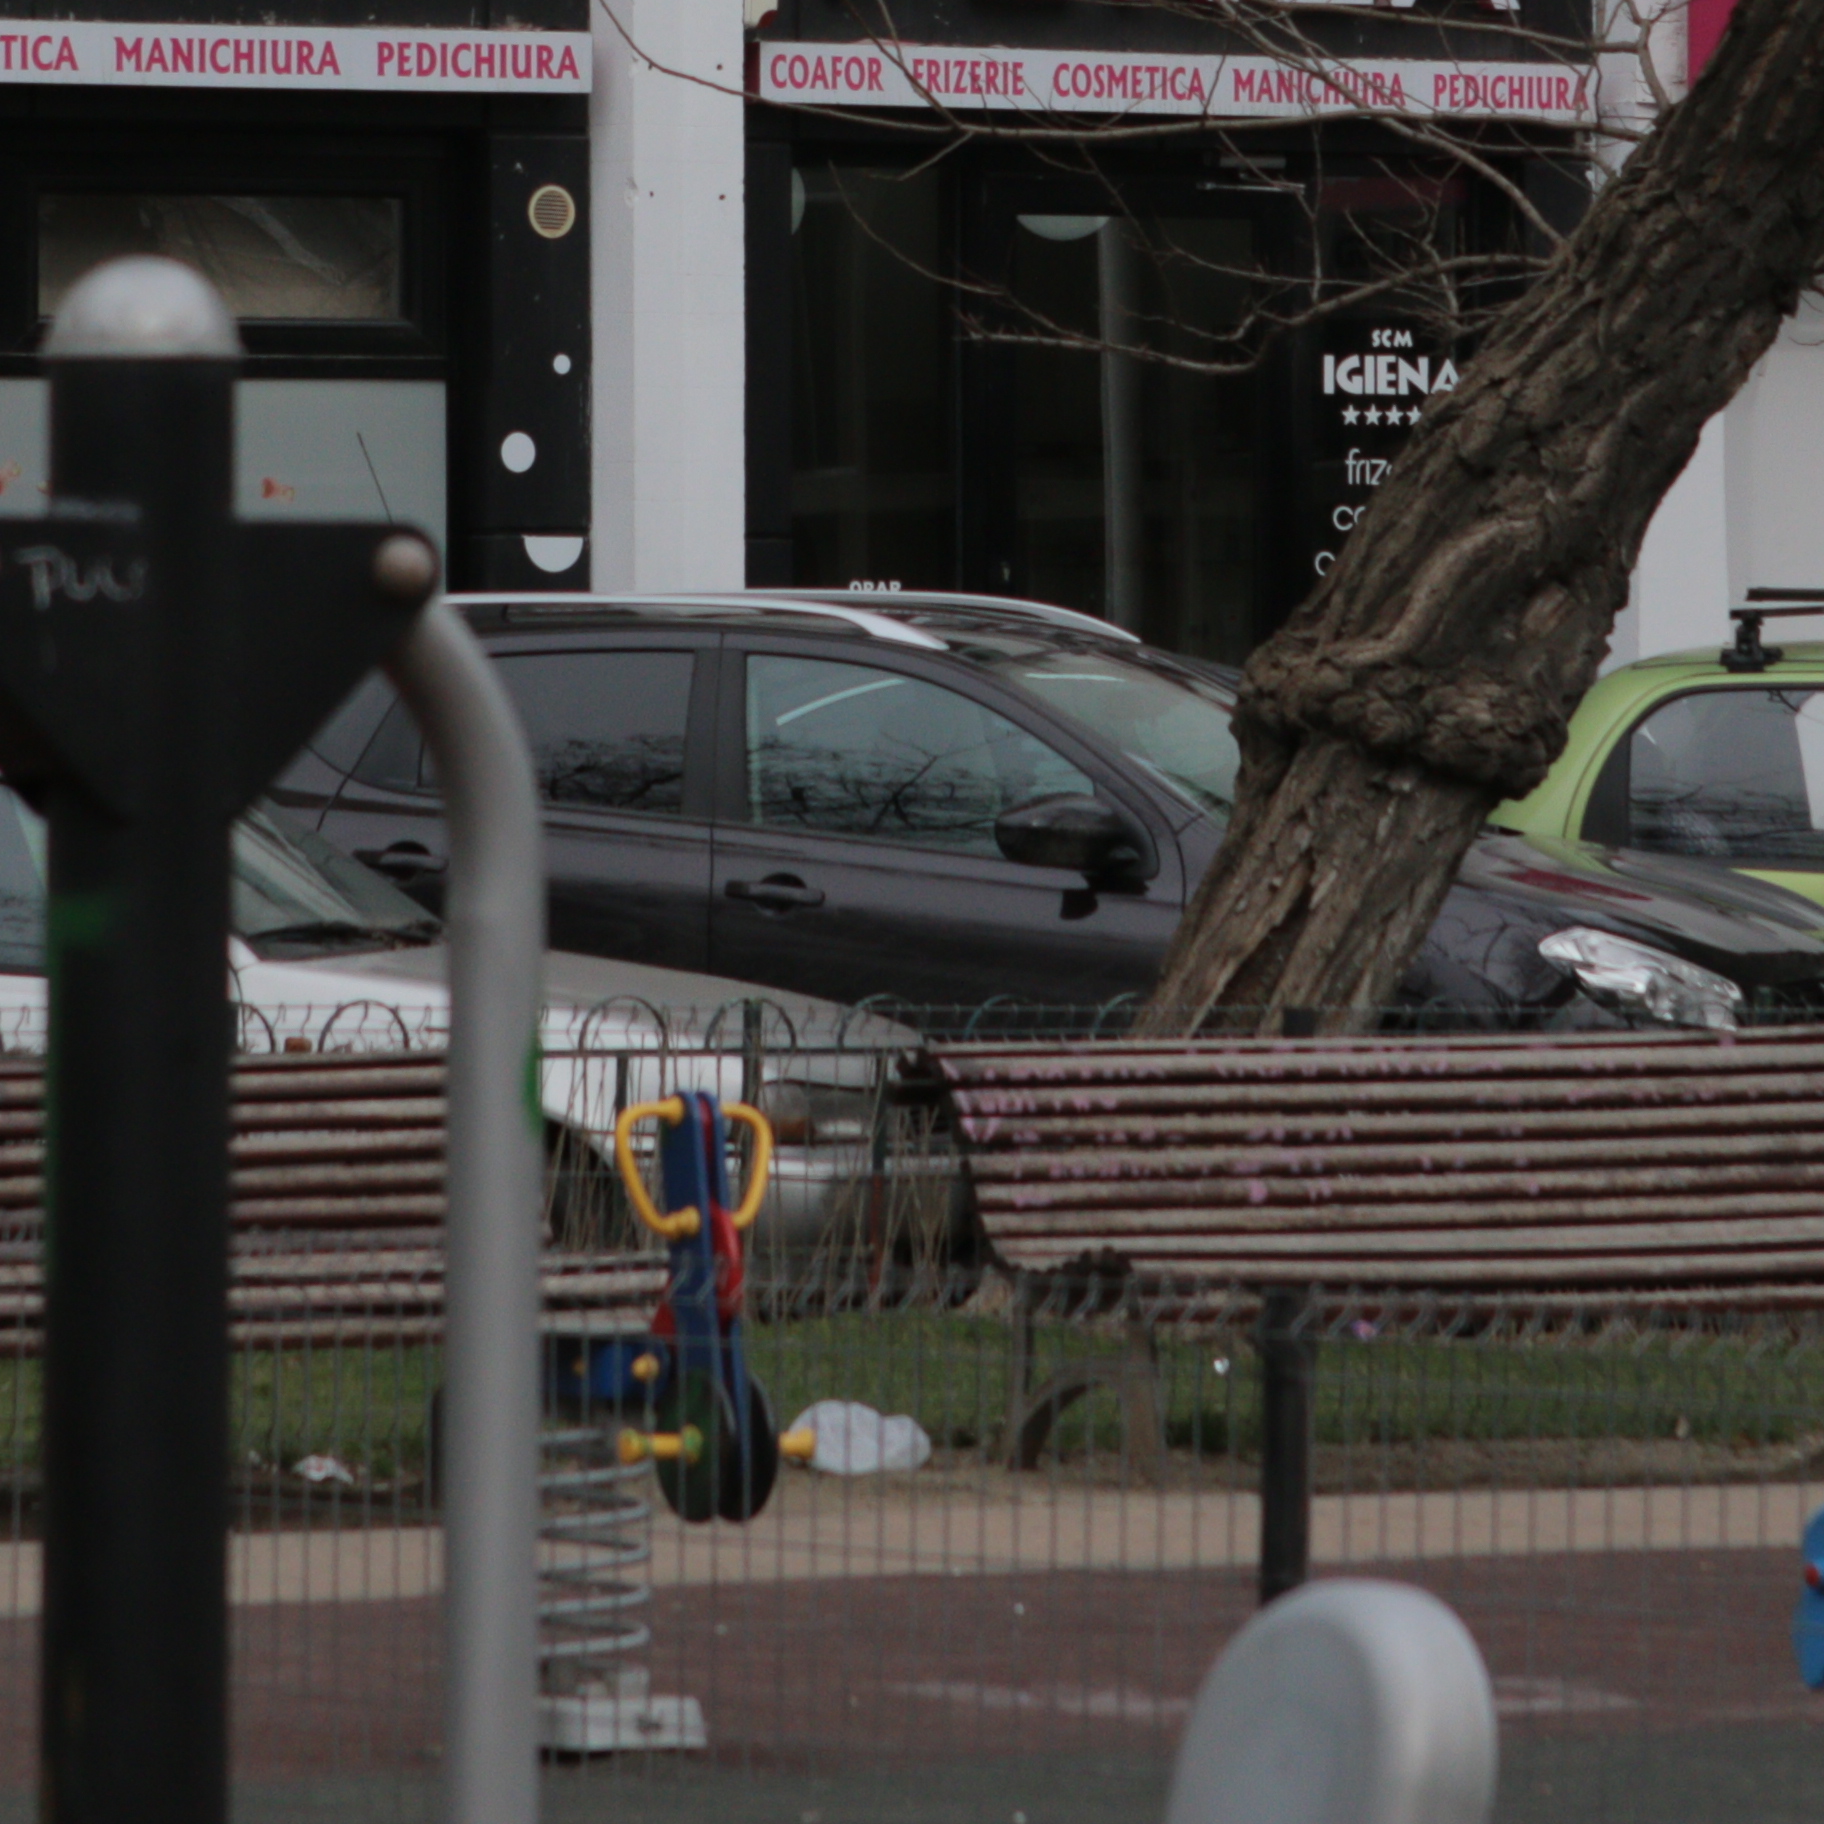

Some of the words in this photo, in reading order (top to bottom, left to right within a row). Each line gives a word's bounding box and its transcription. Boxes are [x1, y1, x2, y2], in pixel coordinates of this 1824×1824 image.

[113, 36, 342, 76] MANICHIURA
[376, 41, 581, 81] PEDICHIURA
[770, 53, 885, 92] COAFOR
[909, 58, 1026, 97] FRIZERIE
[1052, 62, 1207, 102] COSMETICA
[1232, 67, 1408, 109] MANICHIURA
[1432, 73, 1590, 112] PEDICHIURA
[1371, 328, 1414, 348] SCM
[1323, 354, 1460, 396] IGIENA
[1344, 447, 1393, 486] friz
